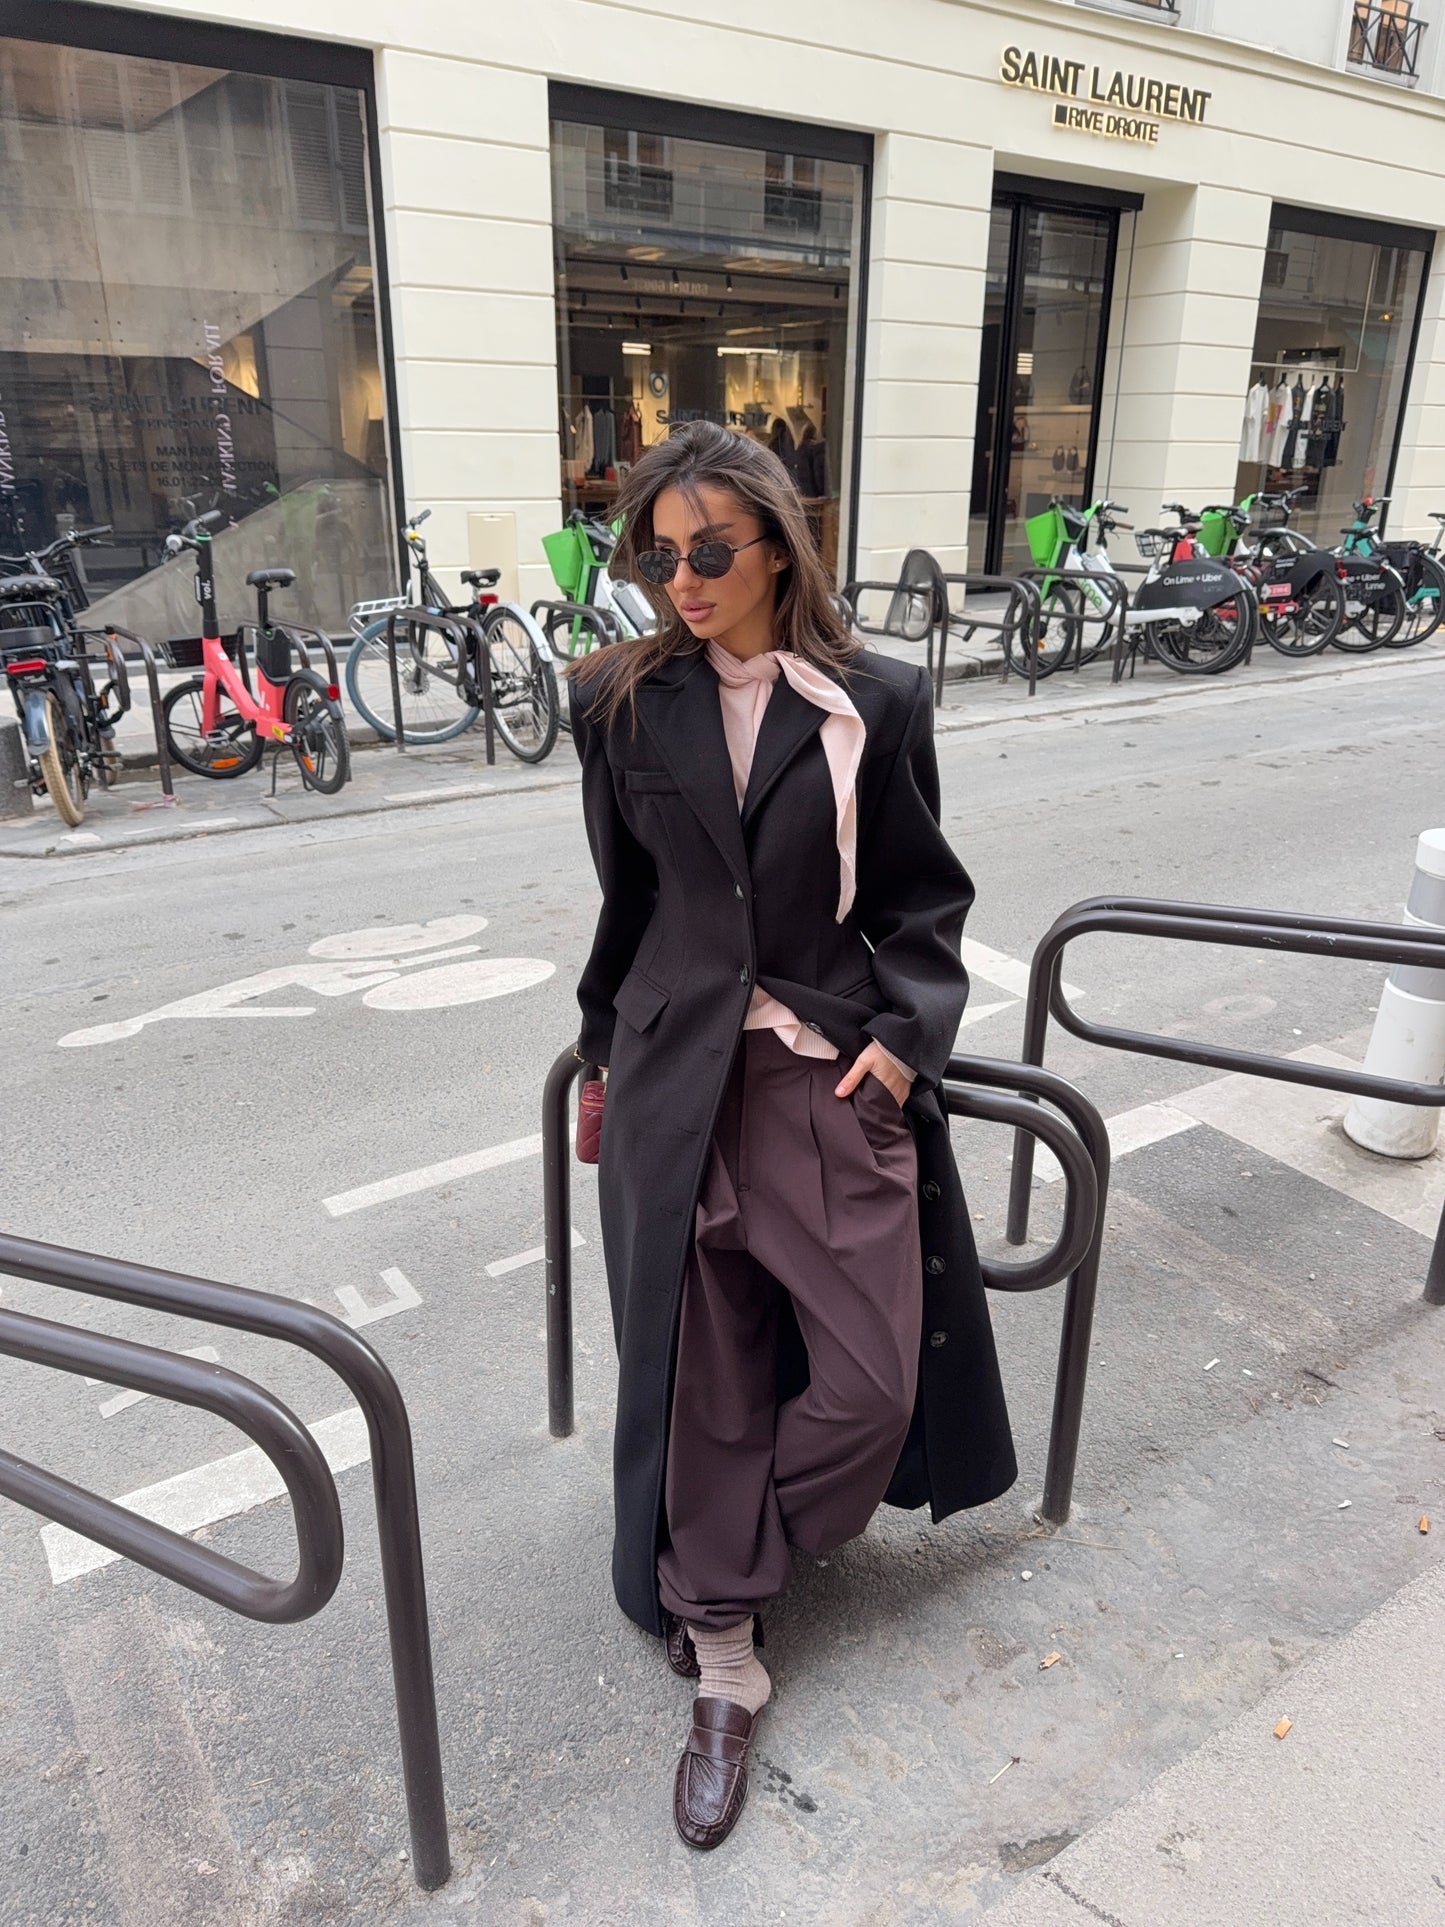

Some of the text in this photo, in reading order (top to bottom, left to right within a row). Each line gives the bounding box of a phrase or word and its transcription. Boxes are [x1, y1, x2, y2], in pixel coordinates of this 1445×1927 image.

[1002, 46, 1212, 122] SAINT LAURENT
[1069, 106, 1160, 142] RIVE DROITE
[1163, 577, 1175, 586] On
[1176, 575, 1194, 584] Lime
[1202, 573, 1222, 582] Uber
